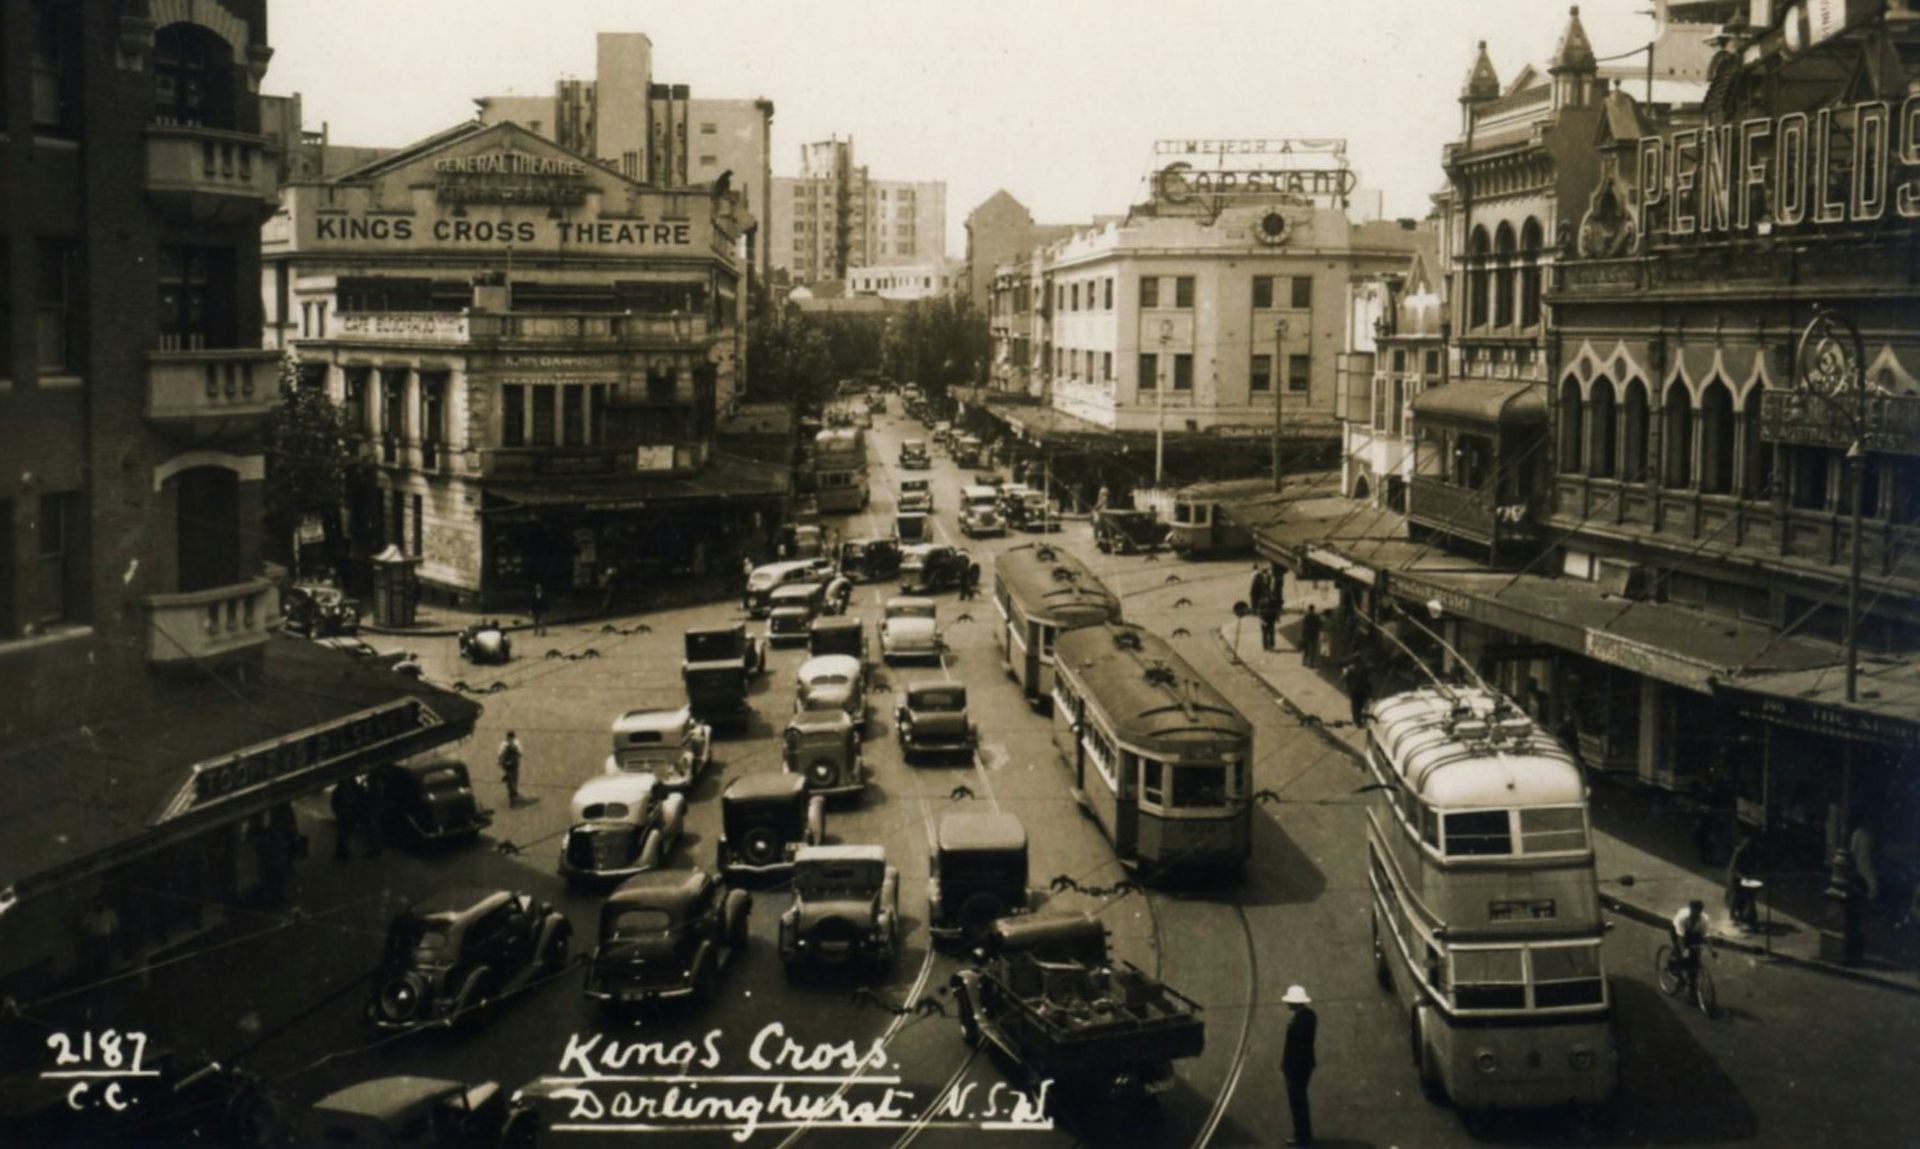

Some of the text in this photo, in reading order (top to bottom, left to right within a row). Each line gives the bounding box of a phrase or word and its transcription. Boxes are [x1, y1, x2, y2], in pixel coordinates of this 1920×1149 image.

[1163, 140, 1293, 154] TIME FOR A
[434, 153, 587, 176] GENERAL THEATRES
[1637, 94, 1920, 238] PENFOLDS
[315, 217, 691, 245] KINGS CROSS THEATRE
